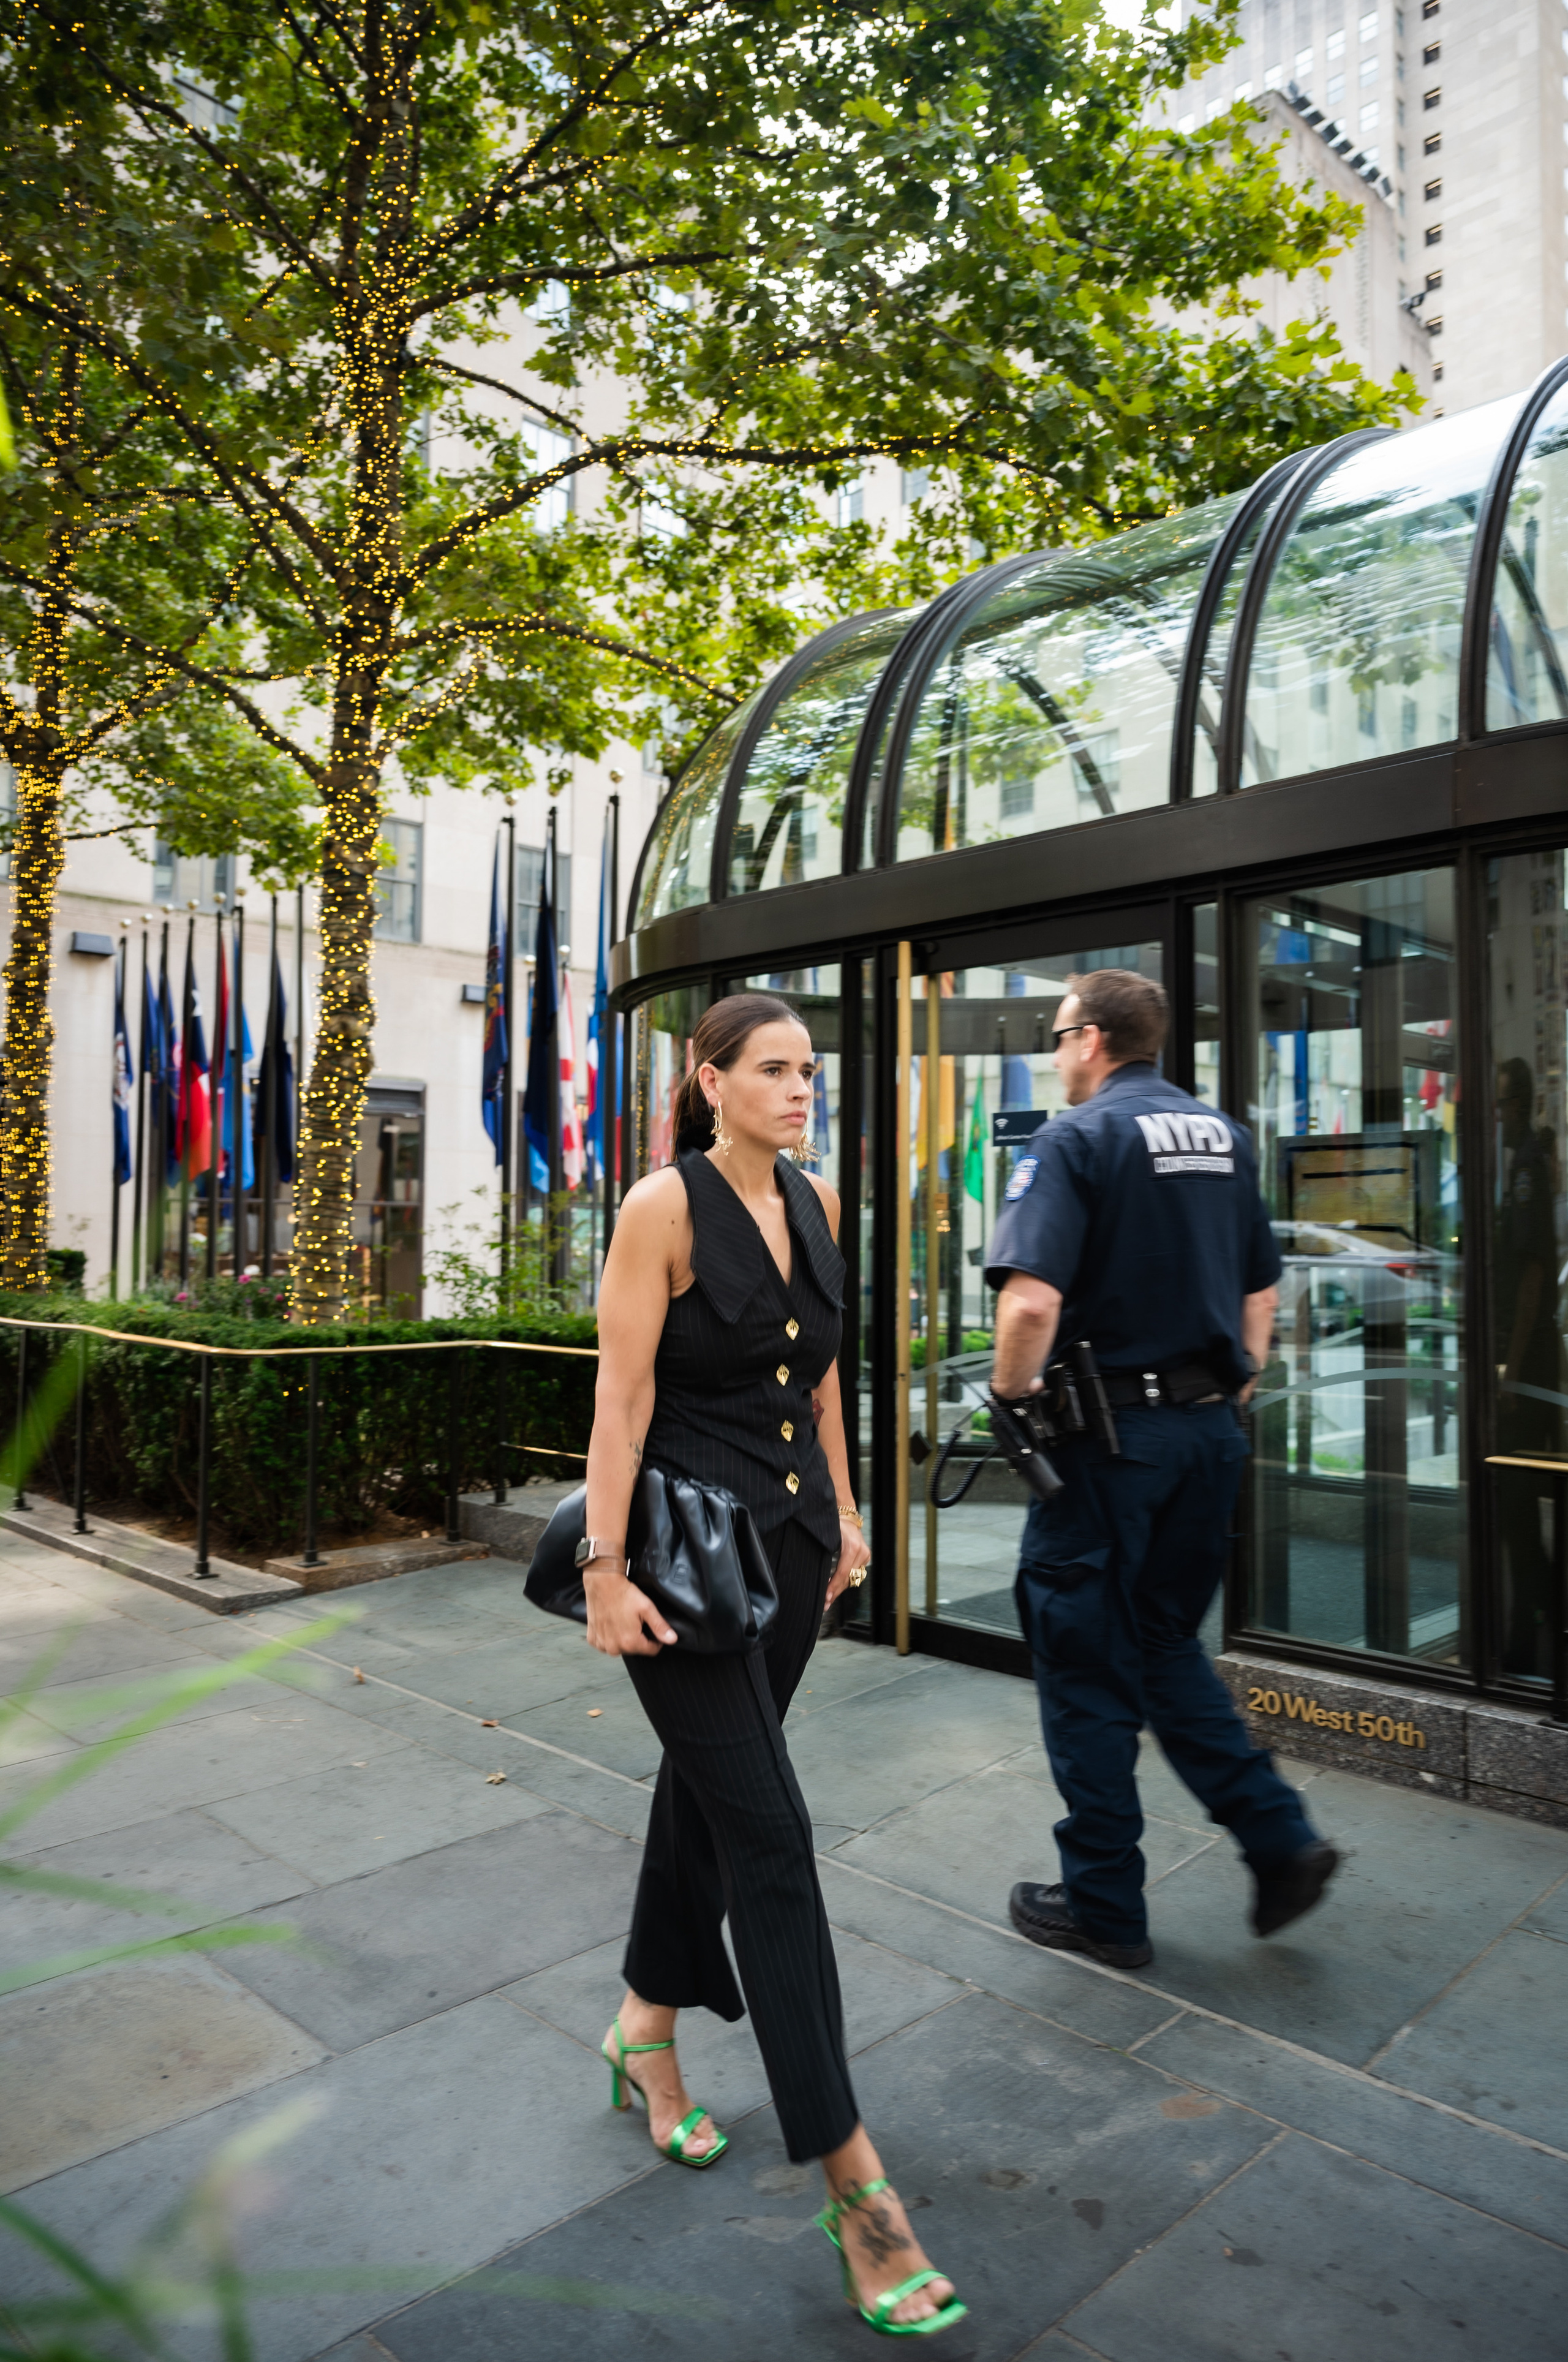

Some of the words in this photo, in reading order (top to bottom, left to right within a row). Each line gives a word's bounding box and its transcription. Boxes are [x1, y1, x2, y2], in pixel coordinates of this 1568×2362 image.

[1134, 1113, 1233, 1152] NYPD
[1247, 1688, 1282, 1715] 20
[1283, 1693, 1354, 1733] West
[1358, 1712, 1426, 1749] 50th
